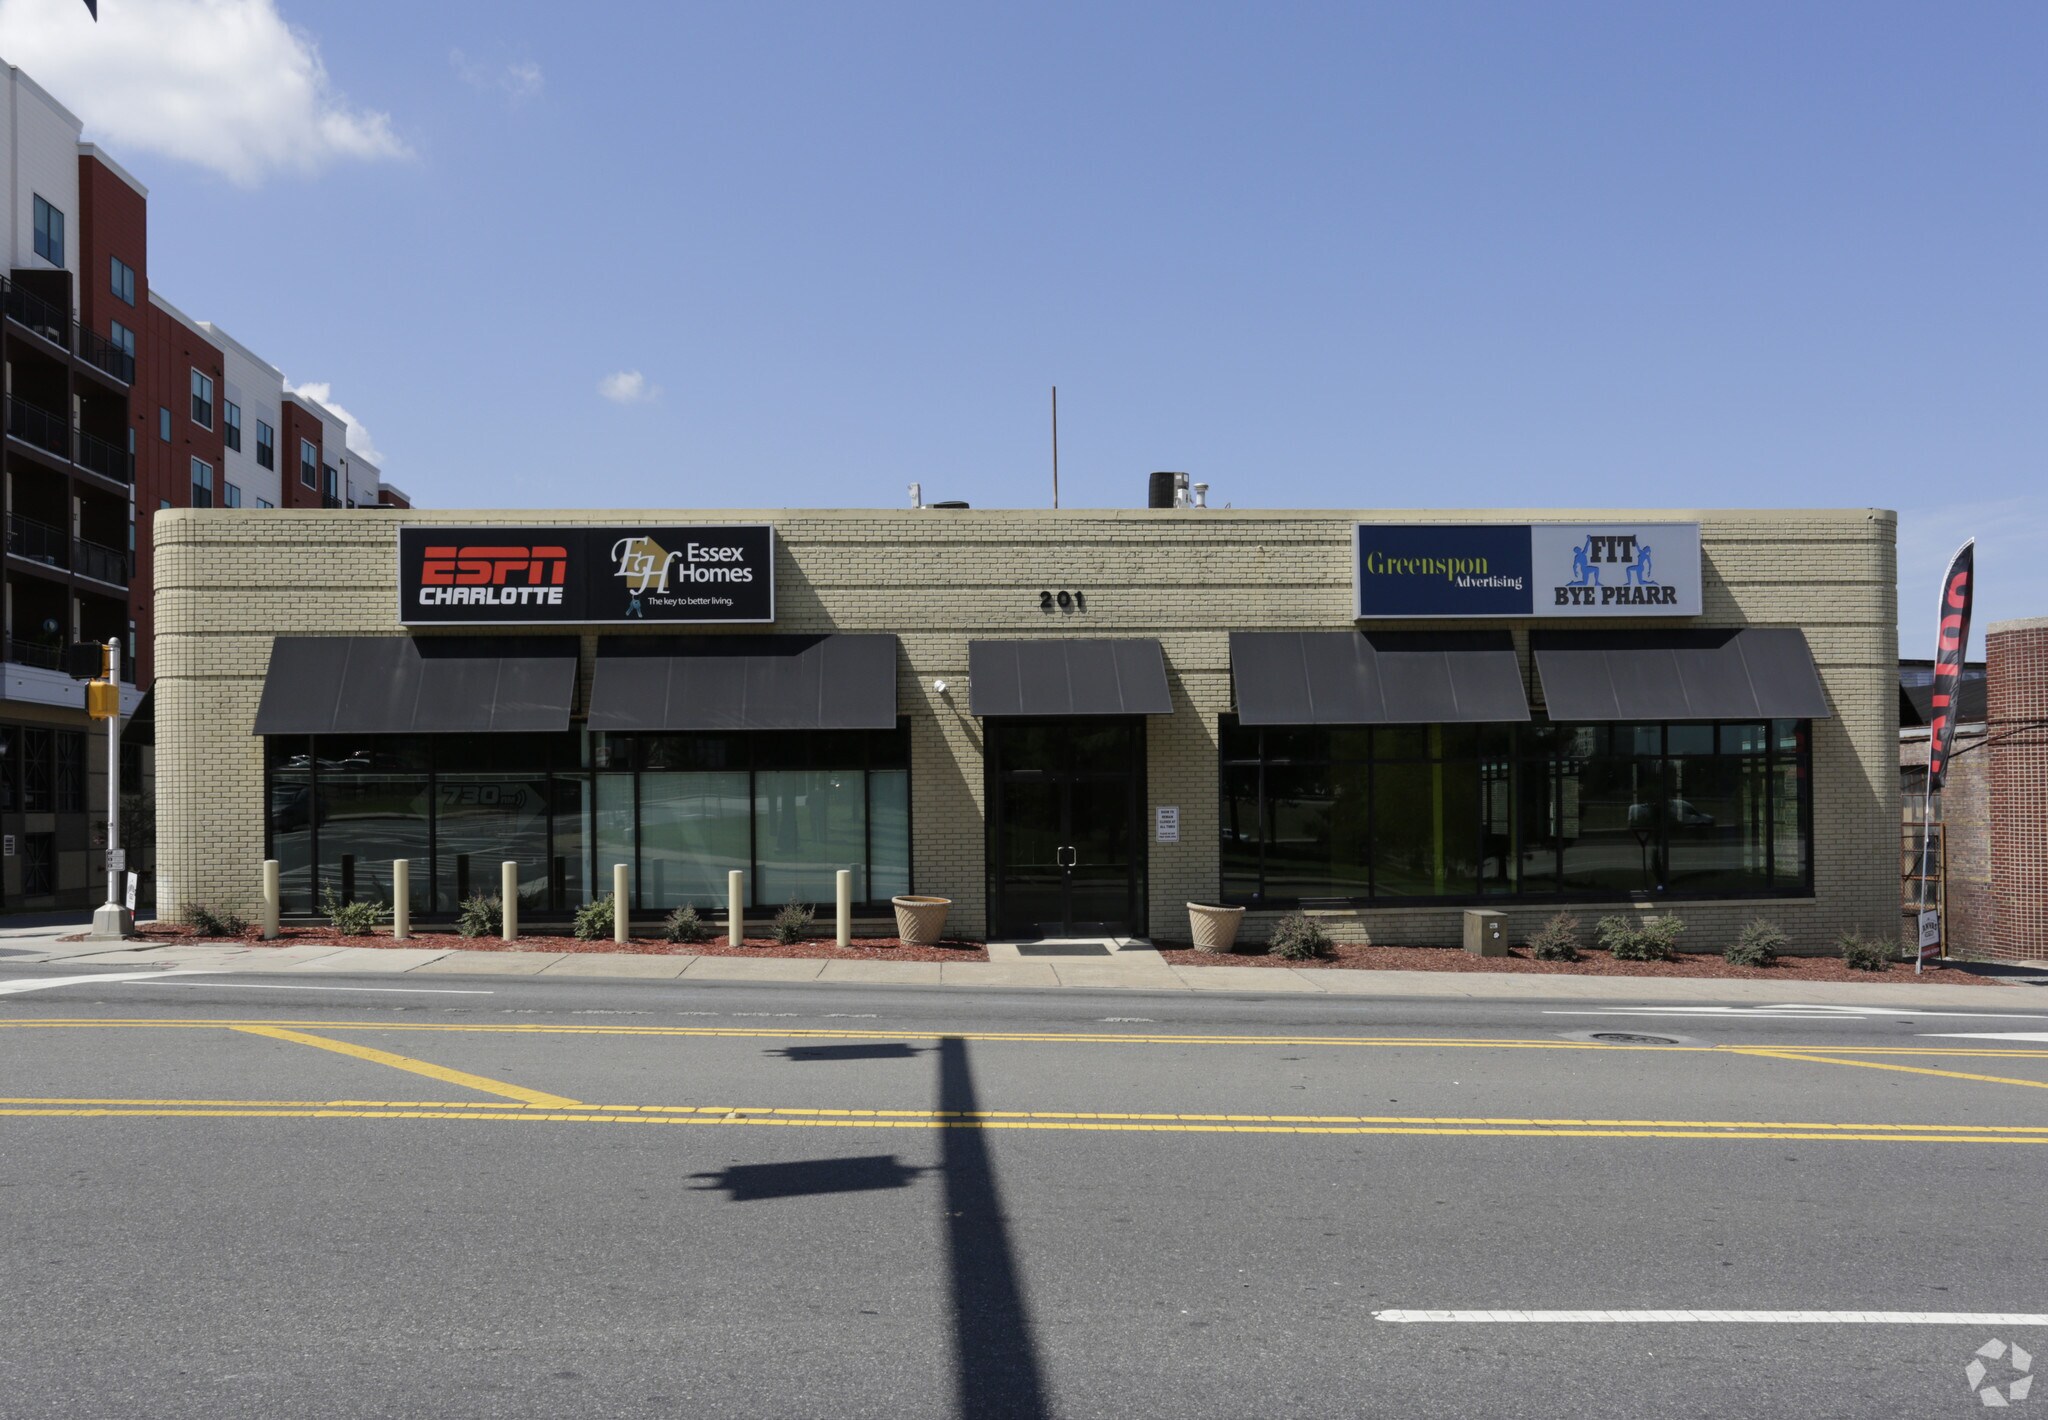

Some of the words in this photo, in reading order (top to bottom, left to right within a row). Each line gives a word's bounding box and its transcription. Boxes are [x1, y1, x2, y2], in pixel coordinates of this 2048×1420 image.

[687, 542, 744, 562] Essex
[1590, 536, 1636, 563] FIT
[421, 546, 568, 585] ESPN
[679, 563, 753, 583] Homes
[1367, 551, 1488, 581] Greenspon
[1454, 575, 1523, 590] Advertising
[418, 587, 563, 605] CHARLOTTE
[648, 597, 662, 605] The
[663, 597, 678, 607] key
[687, 597, 710, 605] better
[711, 597, 734, 607] living.
[1040, 591, 1083, 607] 201
[1554, 586, 1596, 605] BYE
[1601, 586, 1677, 605] PHARR
[443, 785, 500, 804] 730
[1922, 922, 1937, 931] ANVAS
